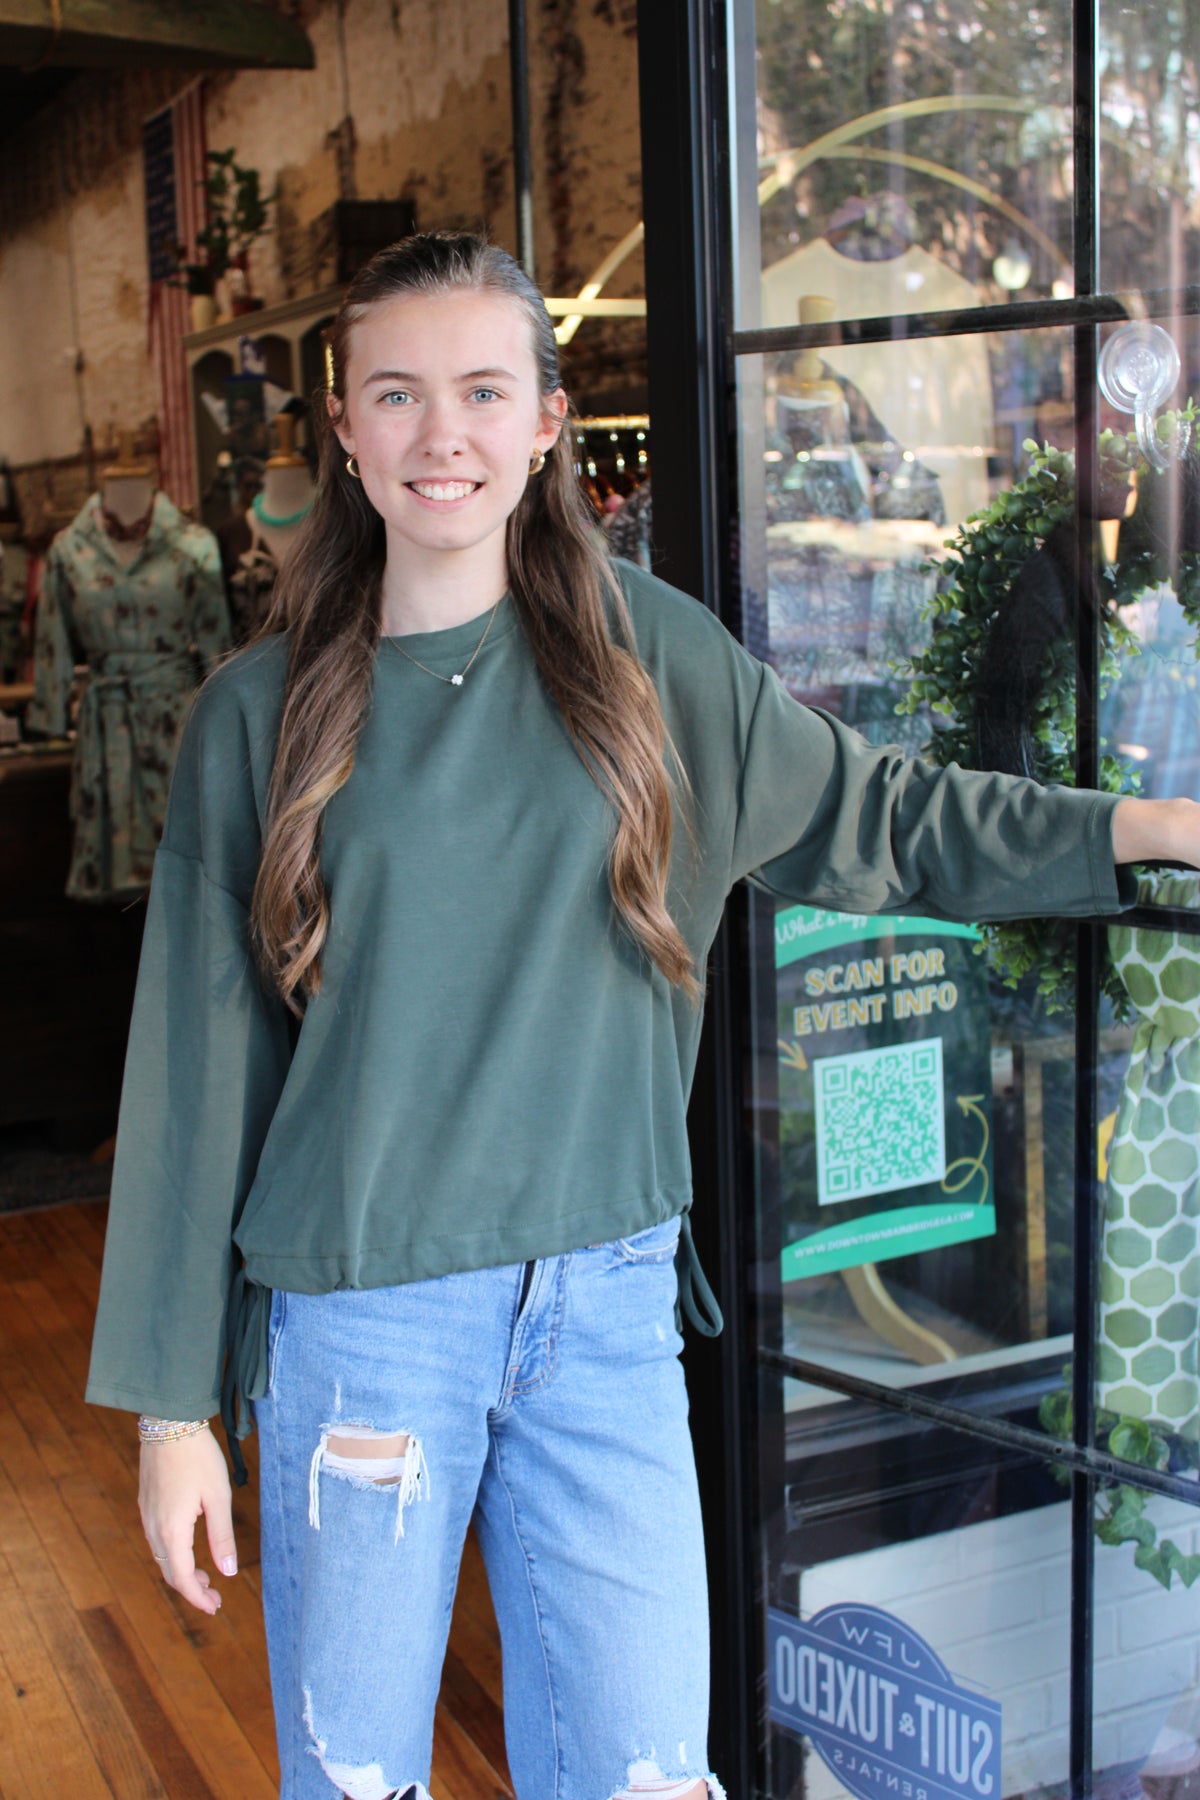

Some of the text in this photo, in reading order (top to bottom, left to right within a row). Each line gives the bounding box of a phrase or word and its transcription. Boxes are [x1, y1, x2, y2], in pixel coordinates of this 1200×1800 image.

[805, 948, 945, 997] SCAN FOR
[794, 981, 958, 1036] EVENT INFO
